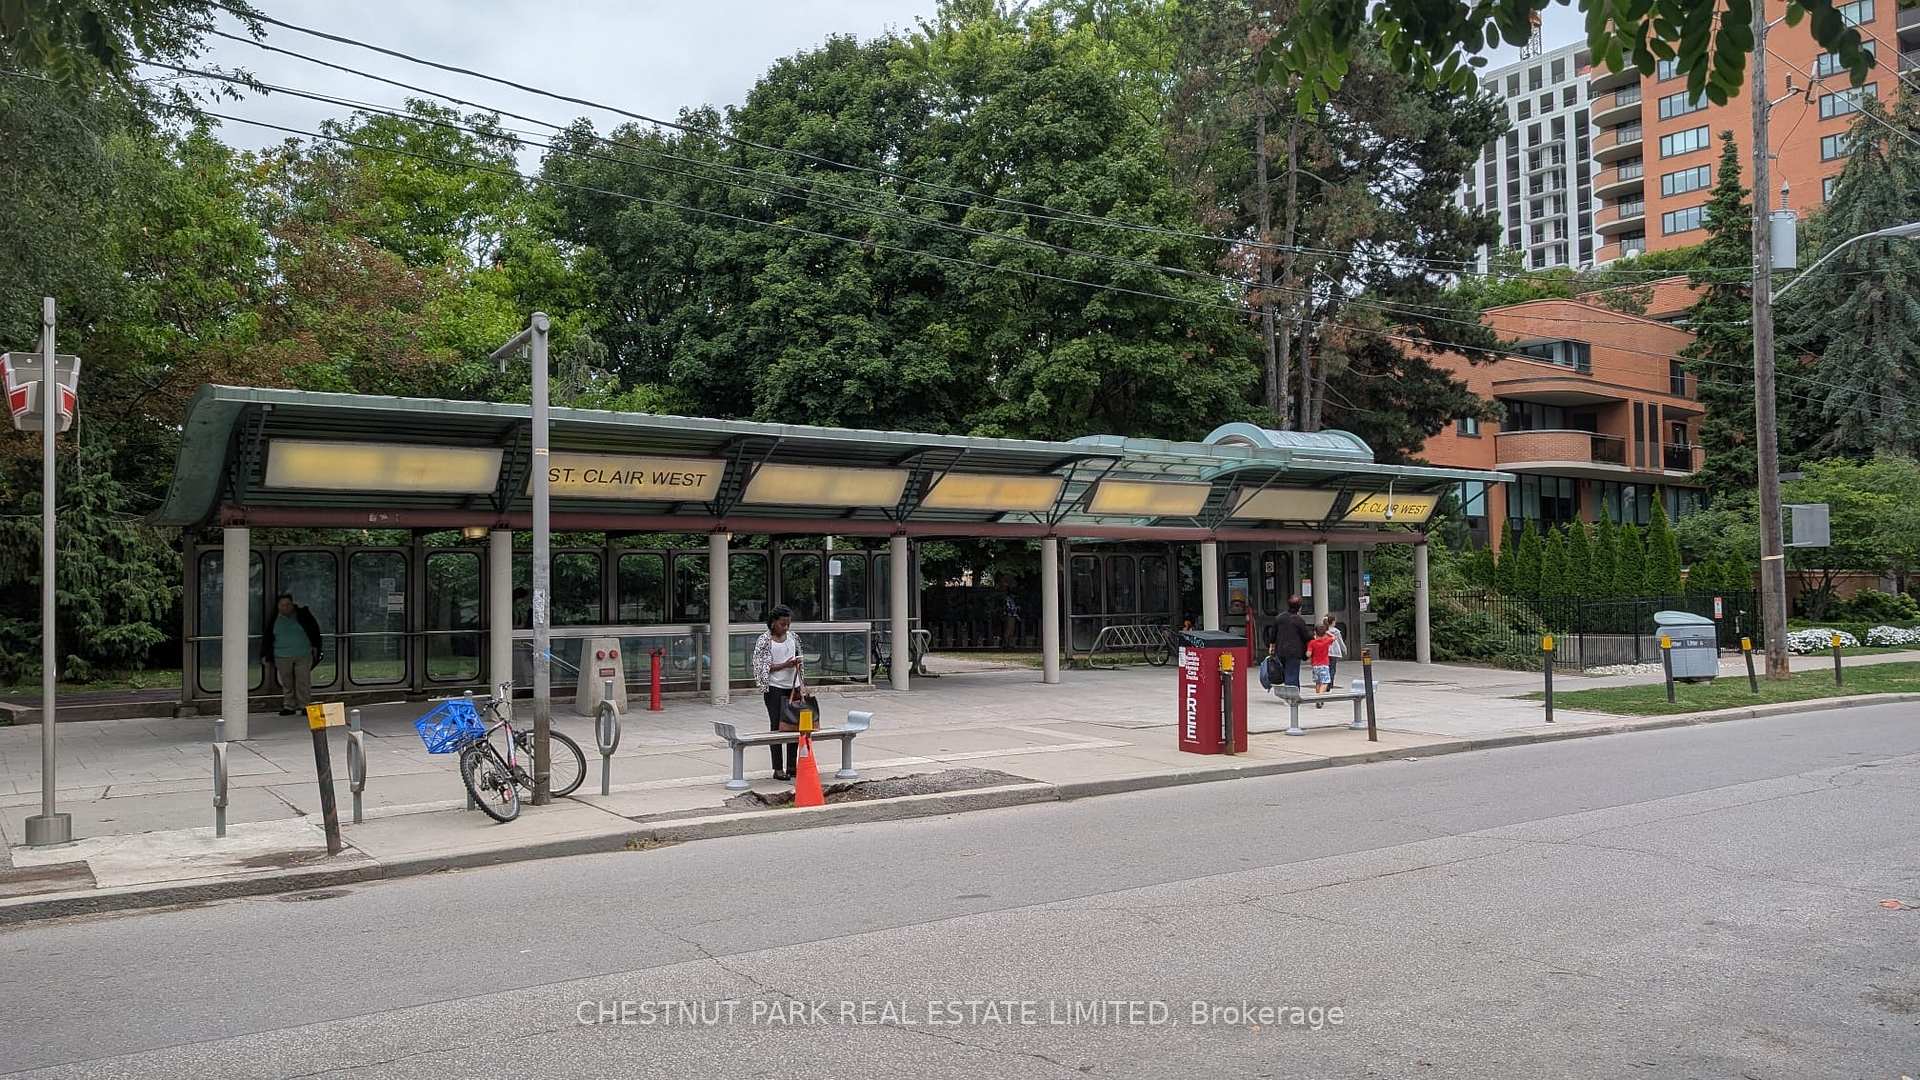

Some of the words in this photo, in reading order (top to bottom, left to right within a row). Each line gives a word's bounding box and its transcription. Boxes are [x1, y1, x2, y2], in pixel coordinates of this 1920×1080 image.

[548, 468, 575, 483] ST.
[583, 469, 644, 485] CLAIR
[652, 471, 707, 487] WEST
[1401, 504, 1428, 514] WEST
[1187, 684, 1197, 739] FREE
